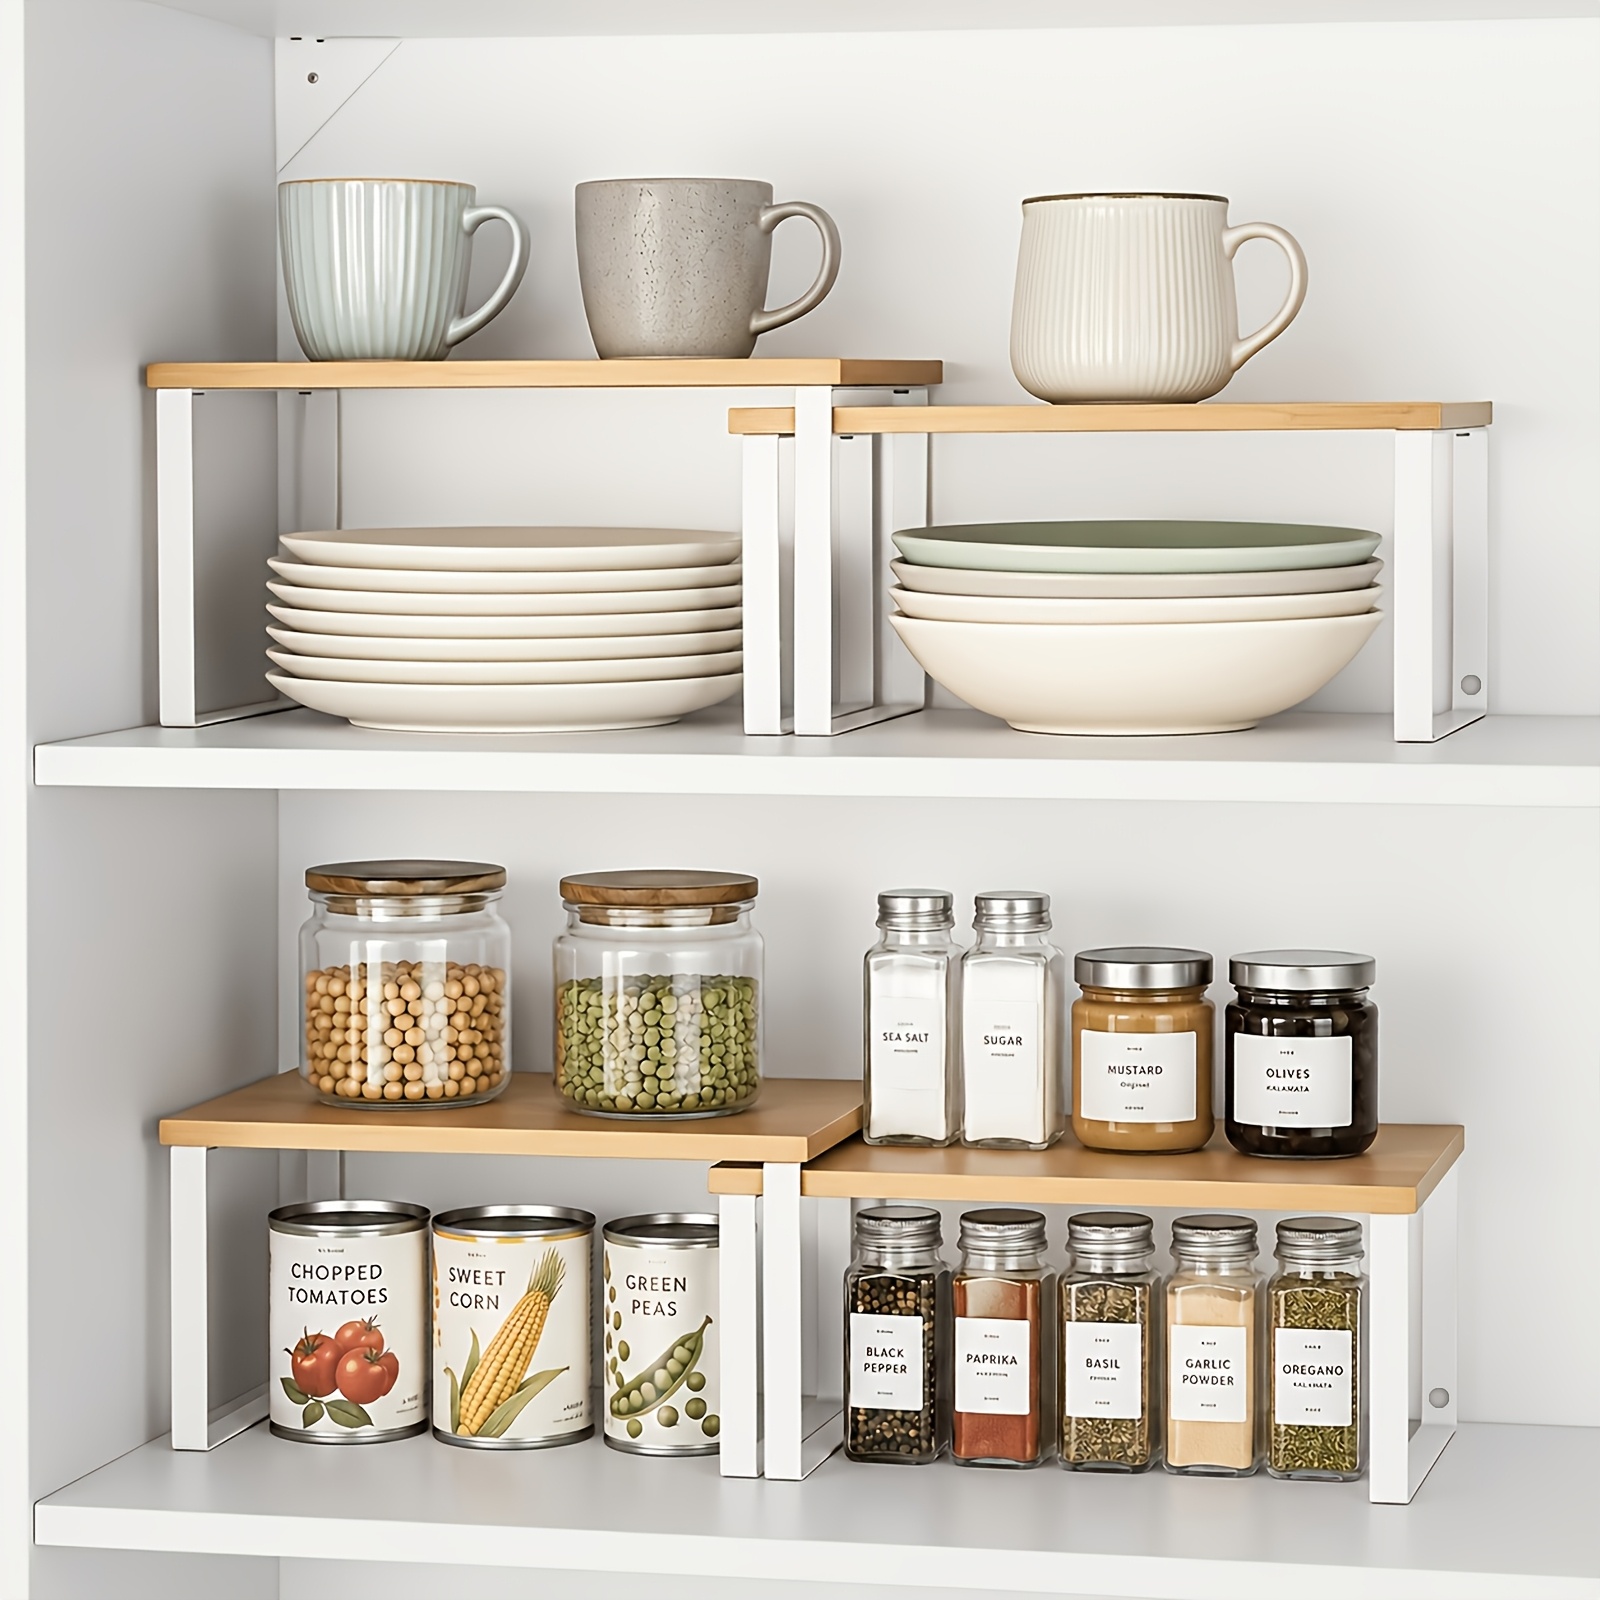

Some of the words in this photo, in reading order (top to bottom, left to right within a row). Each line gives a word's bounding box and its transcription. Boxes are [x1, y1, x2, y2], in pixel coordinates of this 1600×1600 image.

[882, 1032, 902, 1042] SEA
[905, 1033, 929, 1043] SALT
[983, 1035, 1023, 1046] SUGAR
[1107, 1065, 1163, 1075] MUSTARD
[1265, 1068, 1310, 1079] OLIVES
[291, 1262, 382, 1281] CHOPPED
[449, 1267, 506, 1286] SWEET
[625, 1274, 686, 1292] GREEN
[288, 1286, 388, 1305] TOMATOES
[450, 1291, 499, 1310] CORN
[632, 1299, 677, 1316] PEAS
[866, 1346, 905, 1358] BLACK
[966, 1353, 1018, 1365] PAPRIKA
[1085, 1357, 1121, 1369] BASIL
[1185, 1358, 1231, 1370] GARLIC
[863, 1362, 908, 1374] PEPPER
[1282, 1364, 1344, 1376] OREGANO
[1182, 1374, 1235, 1386] POWDER
